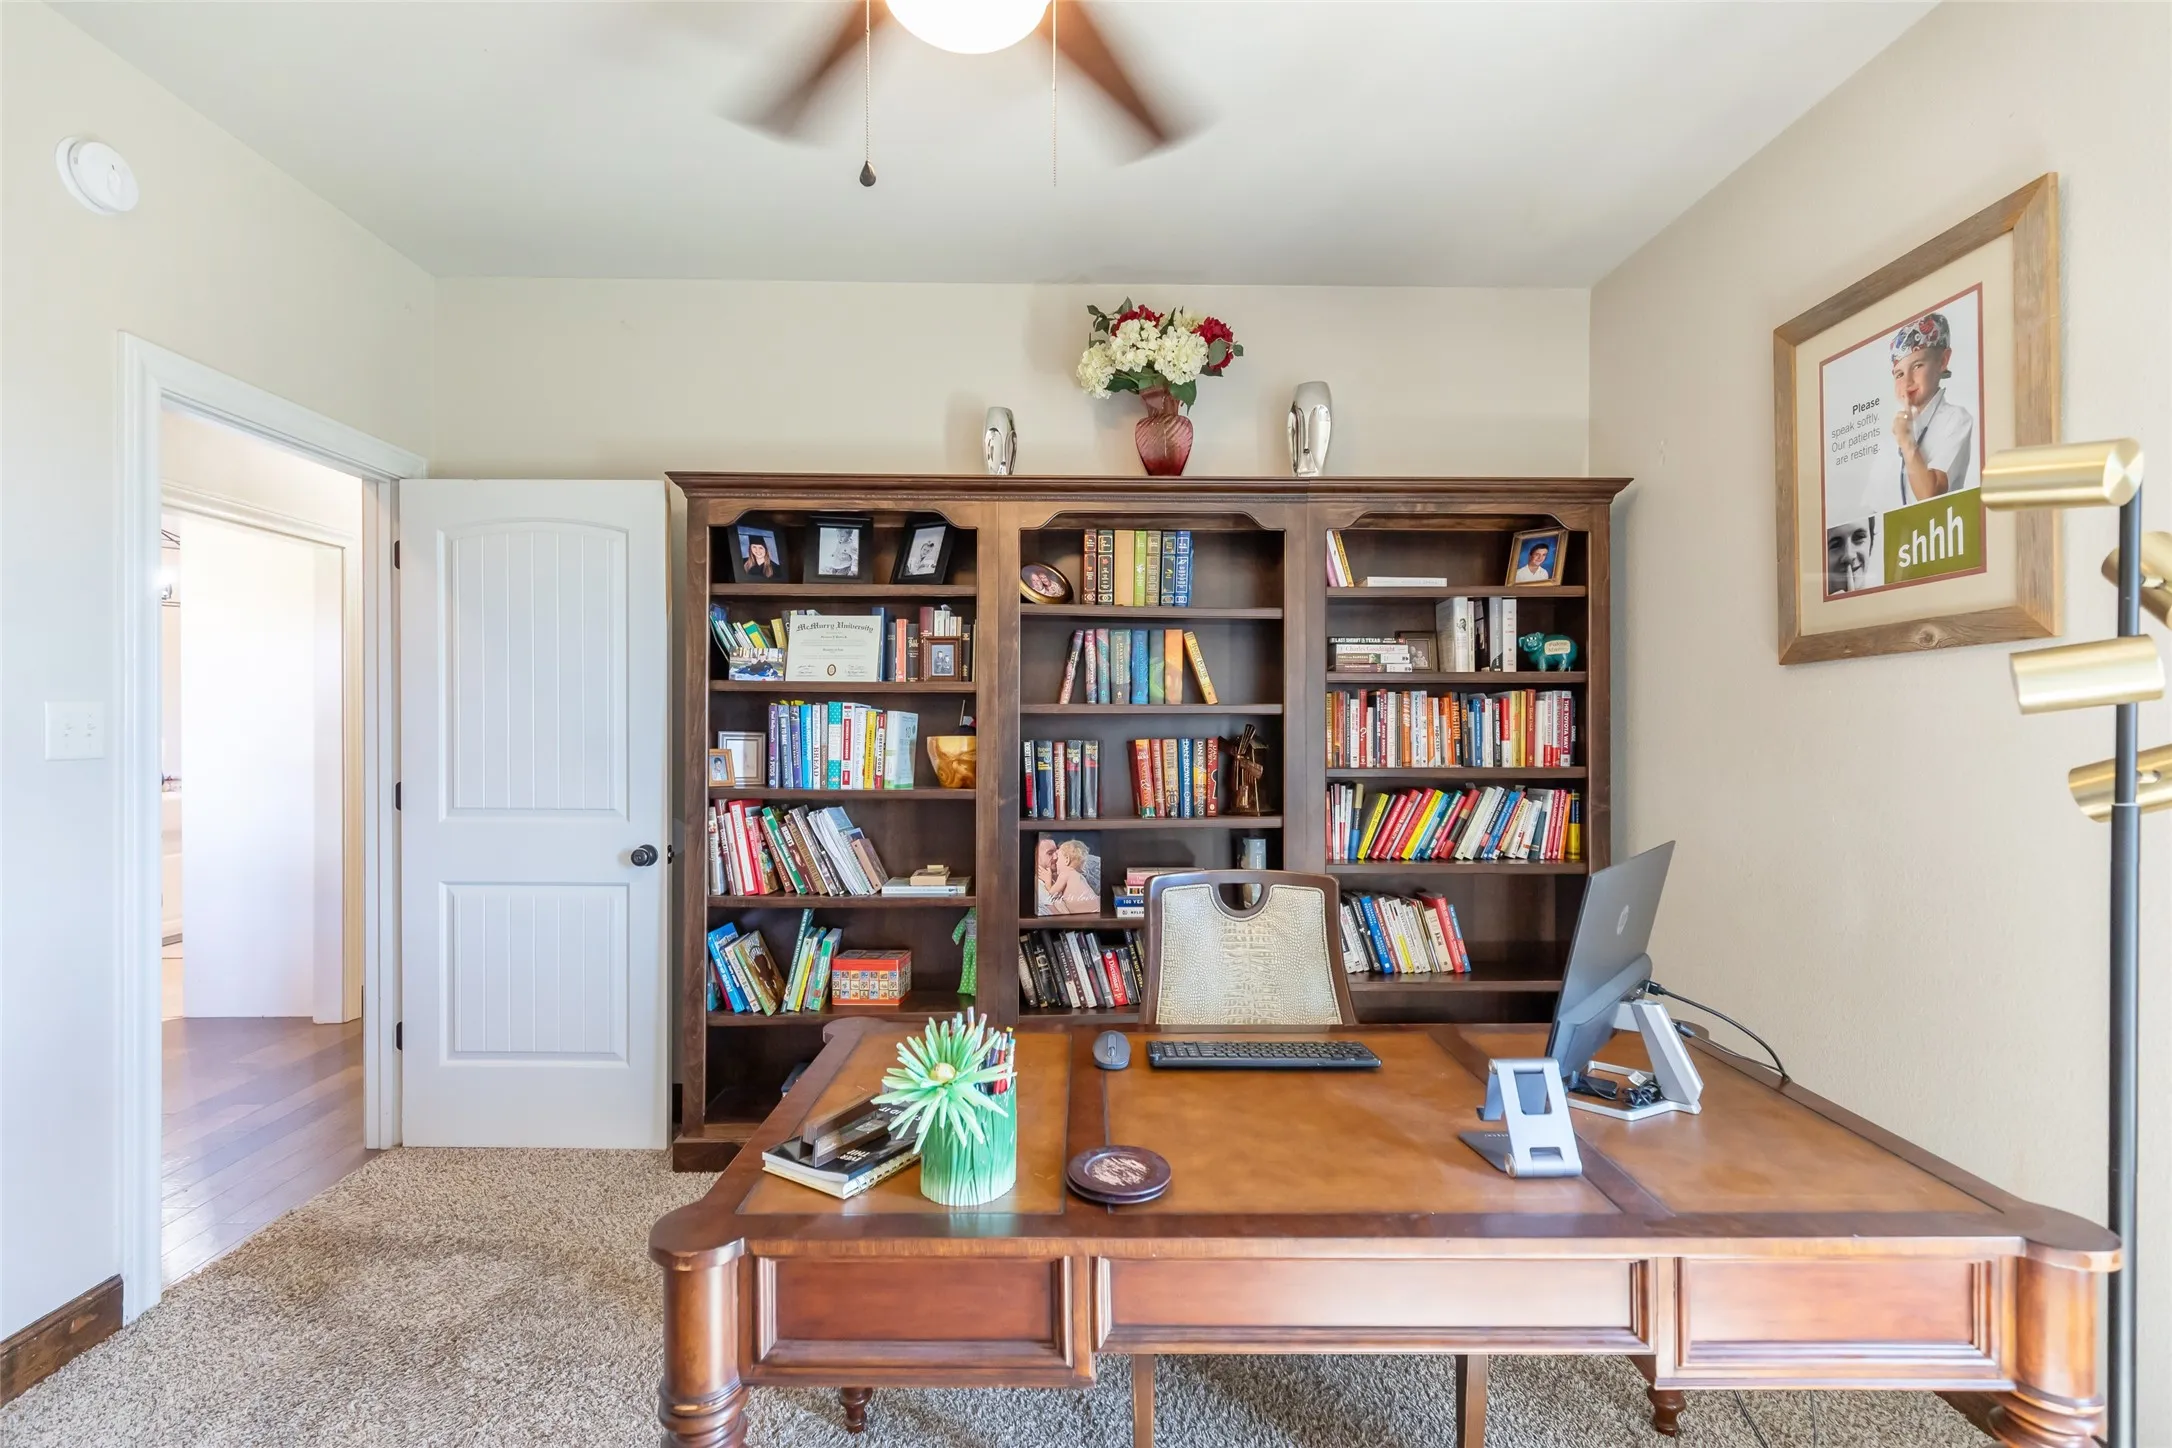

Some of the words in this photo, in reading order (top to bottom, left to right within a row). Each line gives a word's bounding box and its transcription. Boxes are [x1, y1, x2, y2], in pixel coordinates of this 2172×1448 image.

[1852, 397, 1880, 415] Please
[1831, 421, 1854, 439] speak
[1856, 412, 1880, 428] softly.
[1831, 440, 1846, 453] Our
[1848, 427, 1881, 449] patients
[1835, 454, 1849, 466] are
[1850, 443, 1881, 461] resting.
[1898, 506, 1965, 568] shhh
[796, 622, 835, 632] McMurry
[836, 621, 874, 633] University
[1192, 642, 1200, 660] HARRY
[1452, 700, 1460, 740] TRACTION
[1078, 893, 1096, 902] love
[1128, 944, 1137, 960] SHE'S
[1108, 960, 1120, 993] Dictionary
